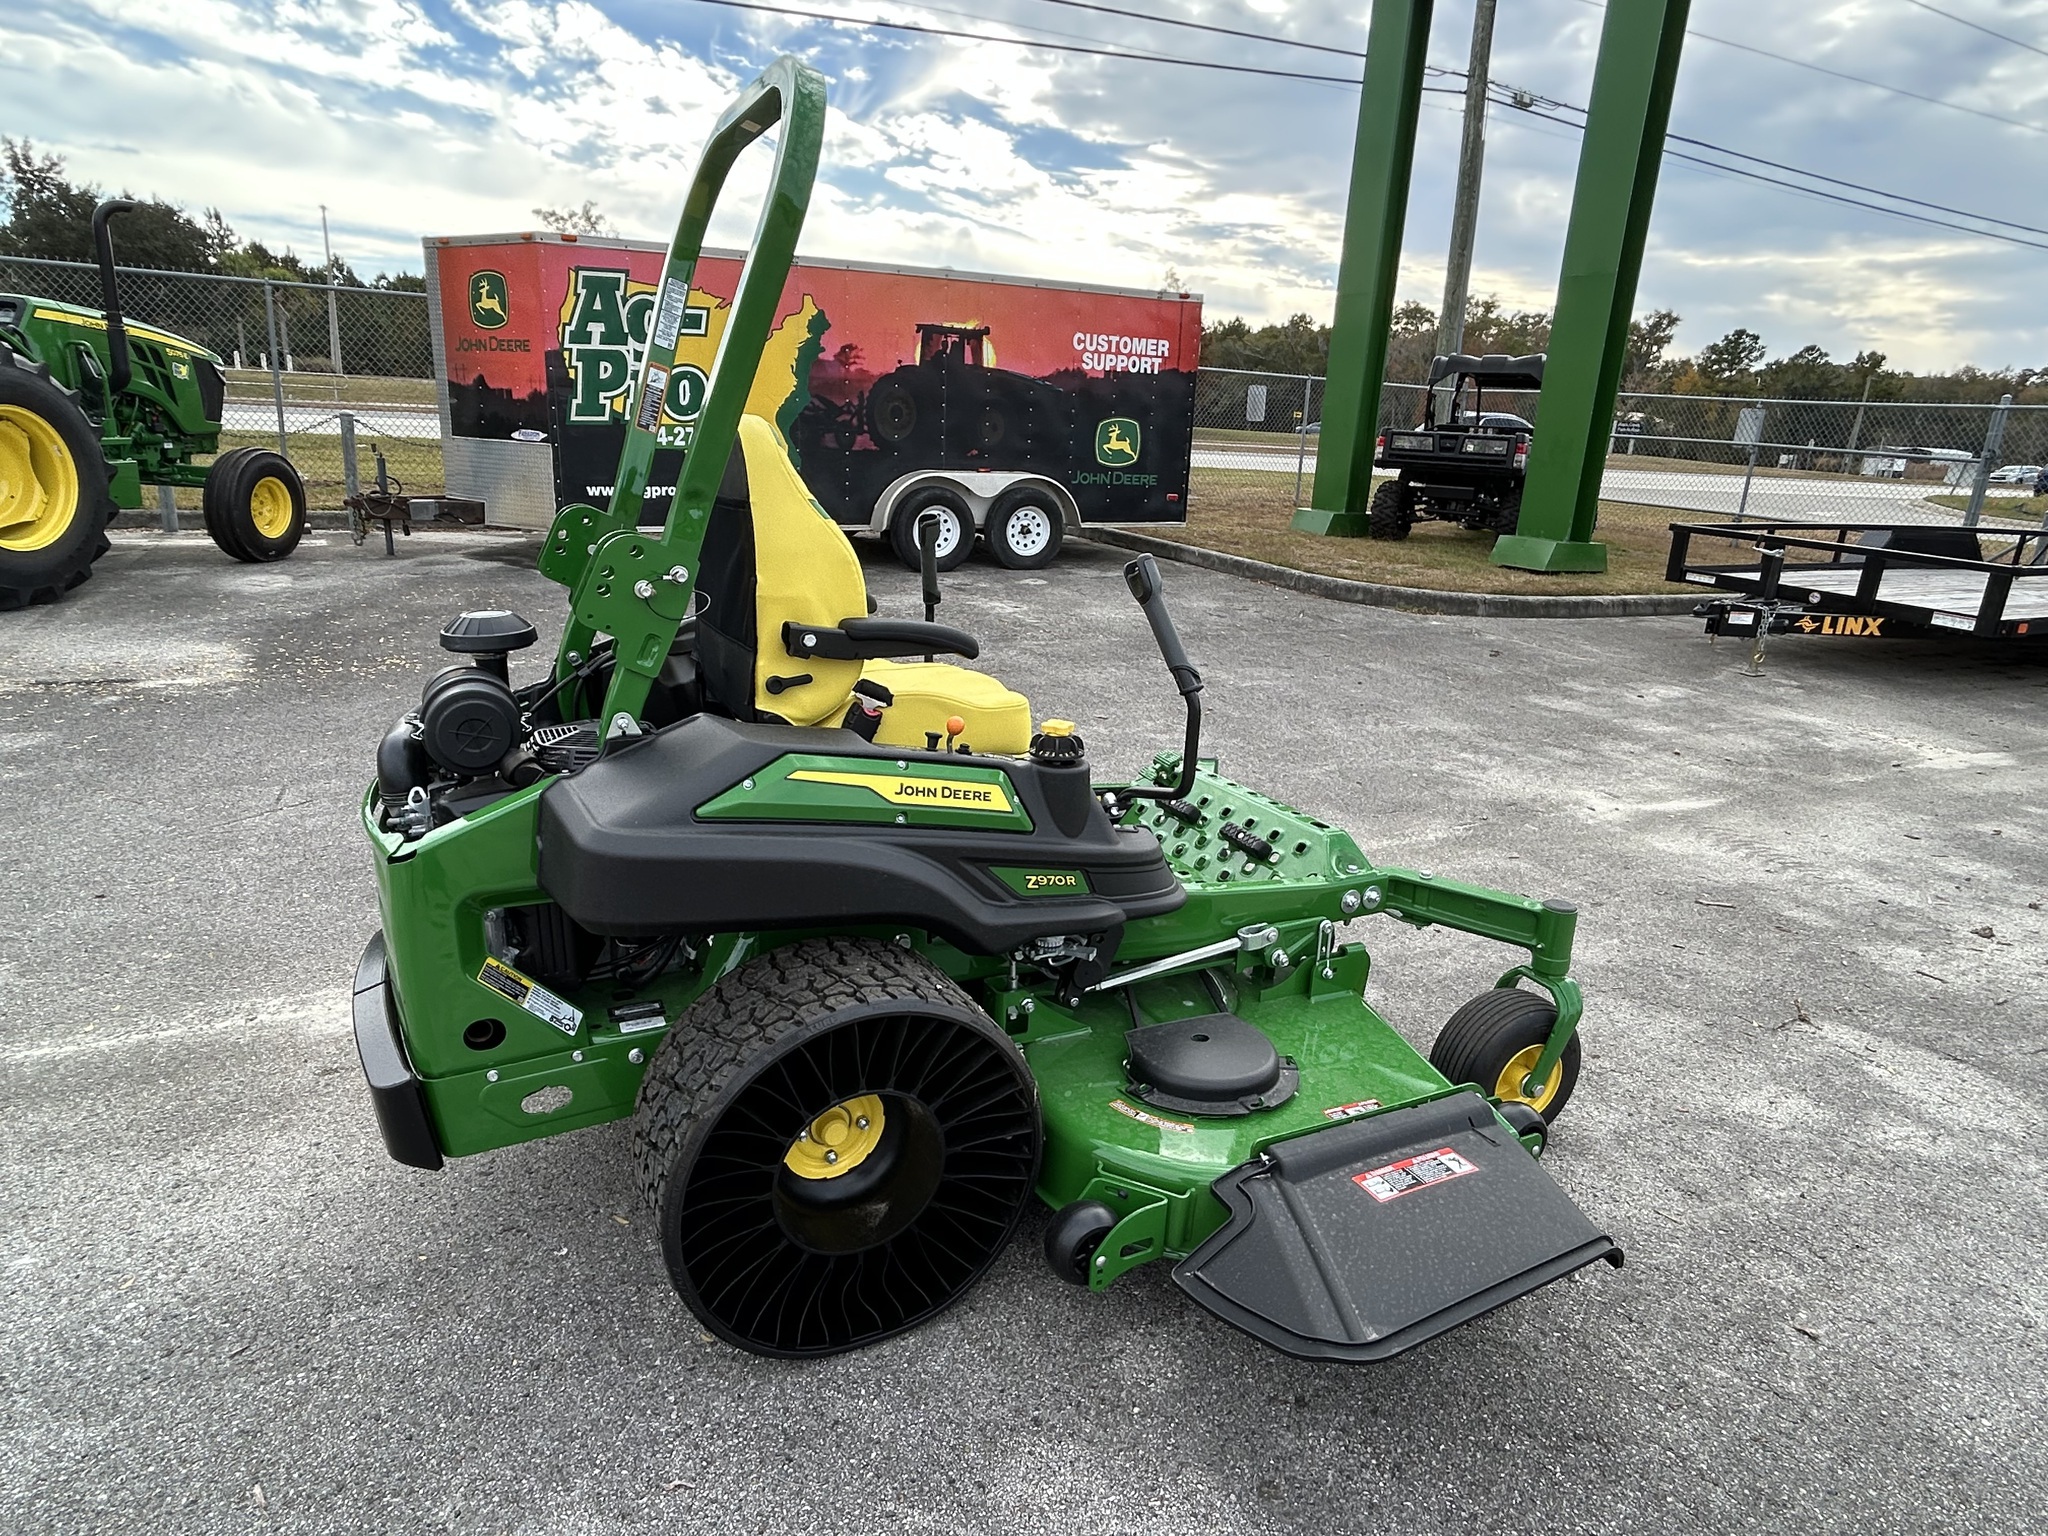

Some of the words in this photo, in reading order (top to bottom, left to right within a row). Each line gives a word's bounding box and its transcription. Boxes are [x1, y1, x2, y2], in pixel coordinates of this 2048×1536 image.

[455, 336, 487, 352] JOHN
[489, 336, 531, 352] DEERE
[1073, 332, 1170, 357] CUSTOMER
[1081, 352, 1163, 374] SUPPORT
[1071, 470, 1111, 485] JOHN
[1113, 472, 1158, 486] DEERE
[1820, 617, 1885, 636] LINX
[894, 782, 937, 798] JOHN
[941, 786, 992, 802] DEERE
[1024, 875, 1077, 889] Z970R
